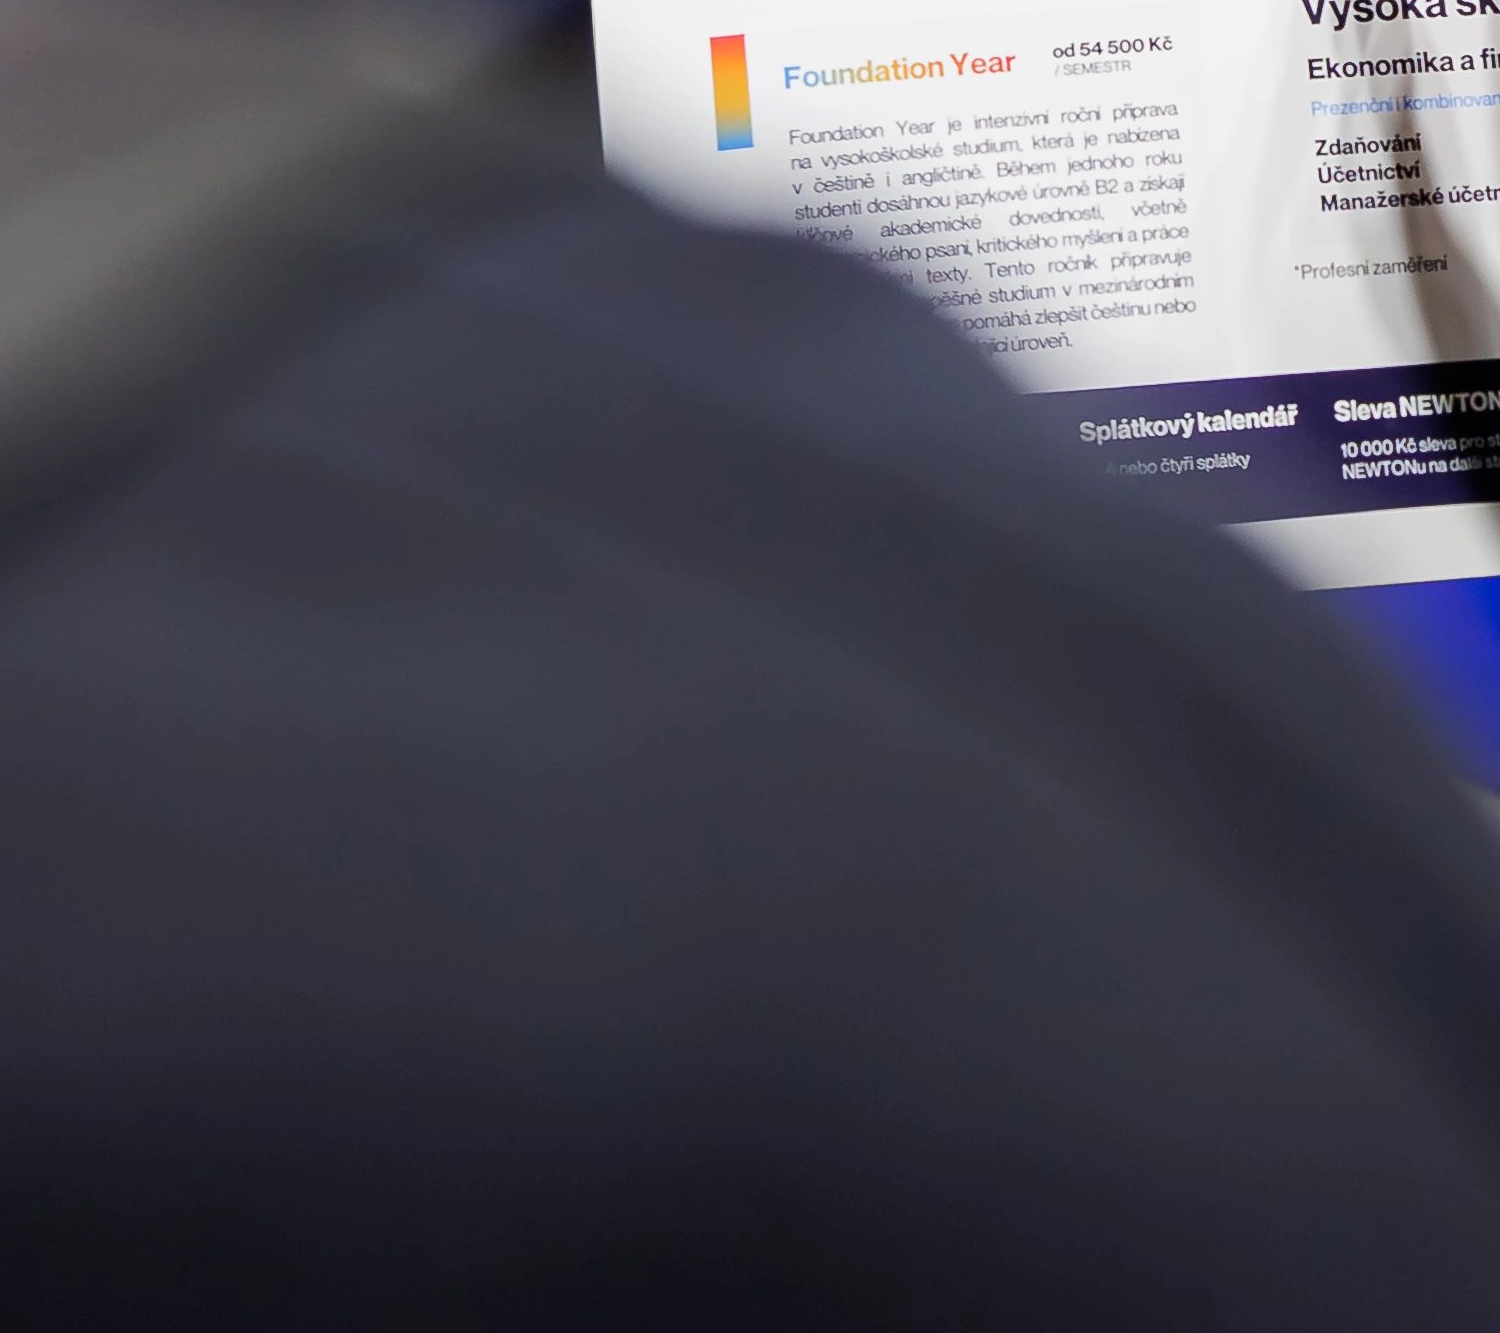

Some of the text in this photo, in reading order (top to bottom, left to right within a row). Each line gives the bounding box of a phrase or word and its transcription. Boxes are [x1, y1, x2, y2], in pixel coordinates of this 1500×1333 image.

[784, 54, 1015, 89] Foundation Year
[1308, 52, 1454, 79] Ekonomika
[1461, 55, 1475, 70] a
[1315, 133, 1421, 156] Zdaňování
[1318, 160, 1423, 183] Účetnictví
[1321, 187, 1444, 212] Manažerské
[1333, 399, 1398, 423] Sleva
[1080, 404, 1298, 445] Splátkový kalendář
